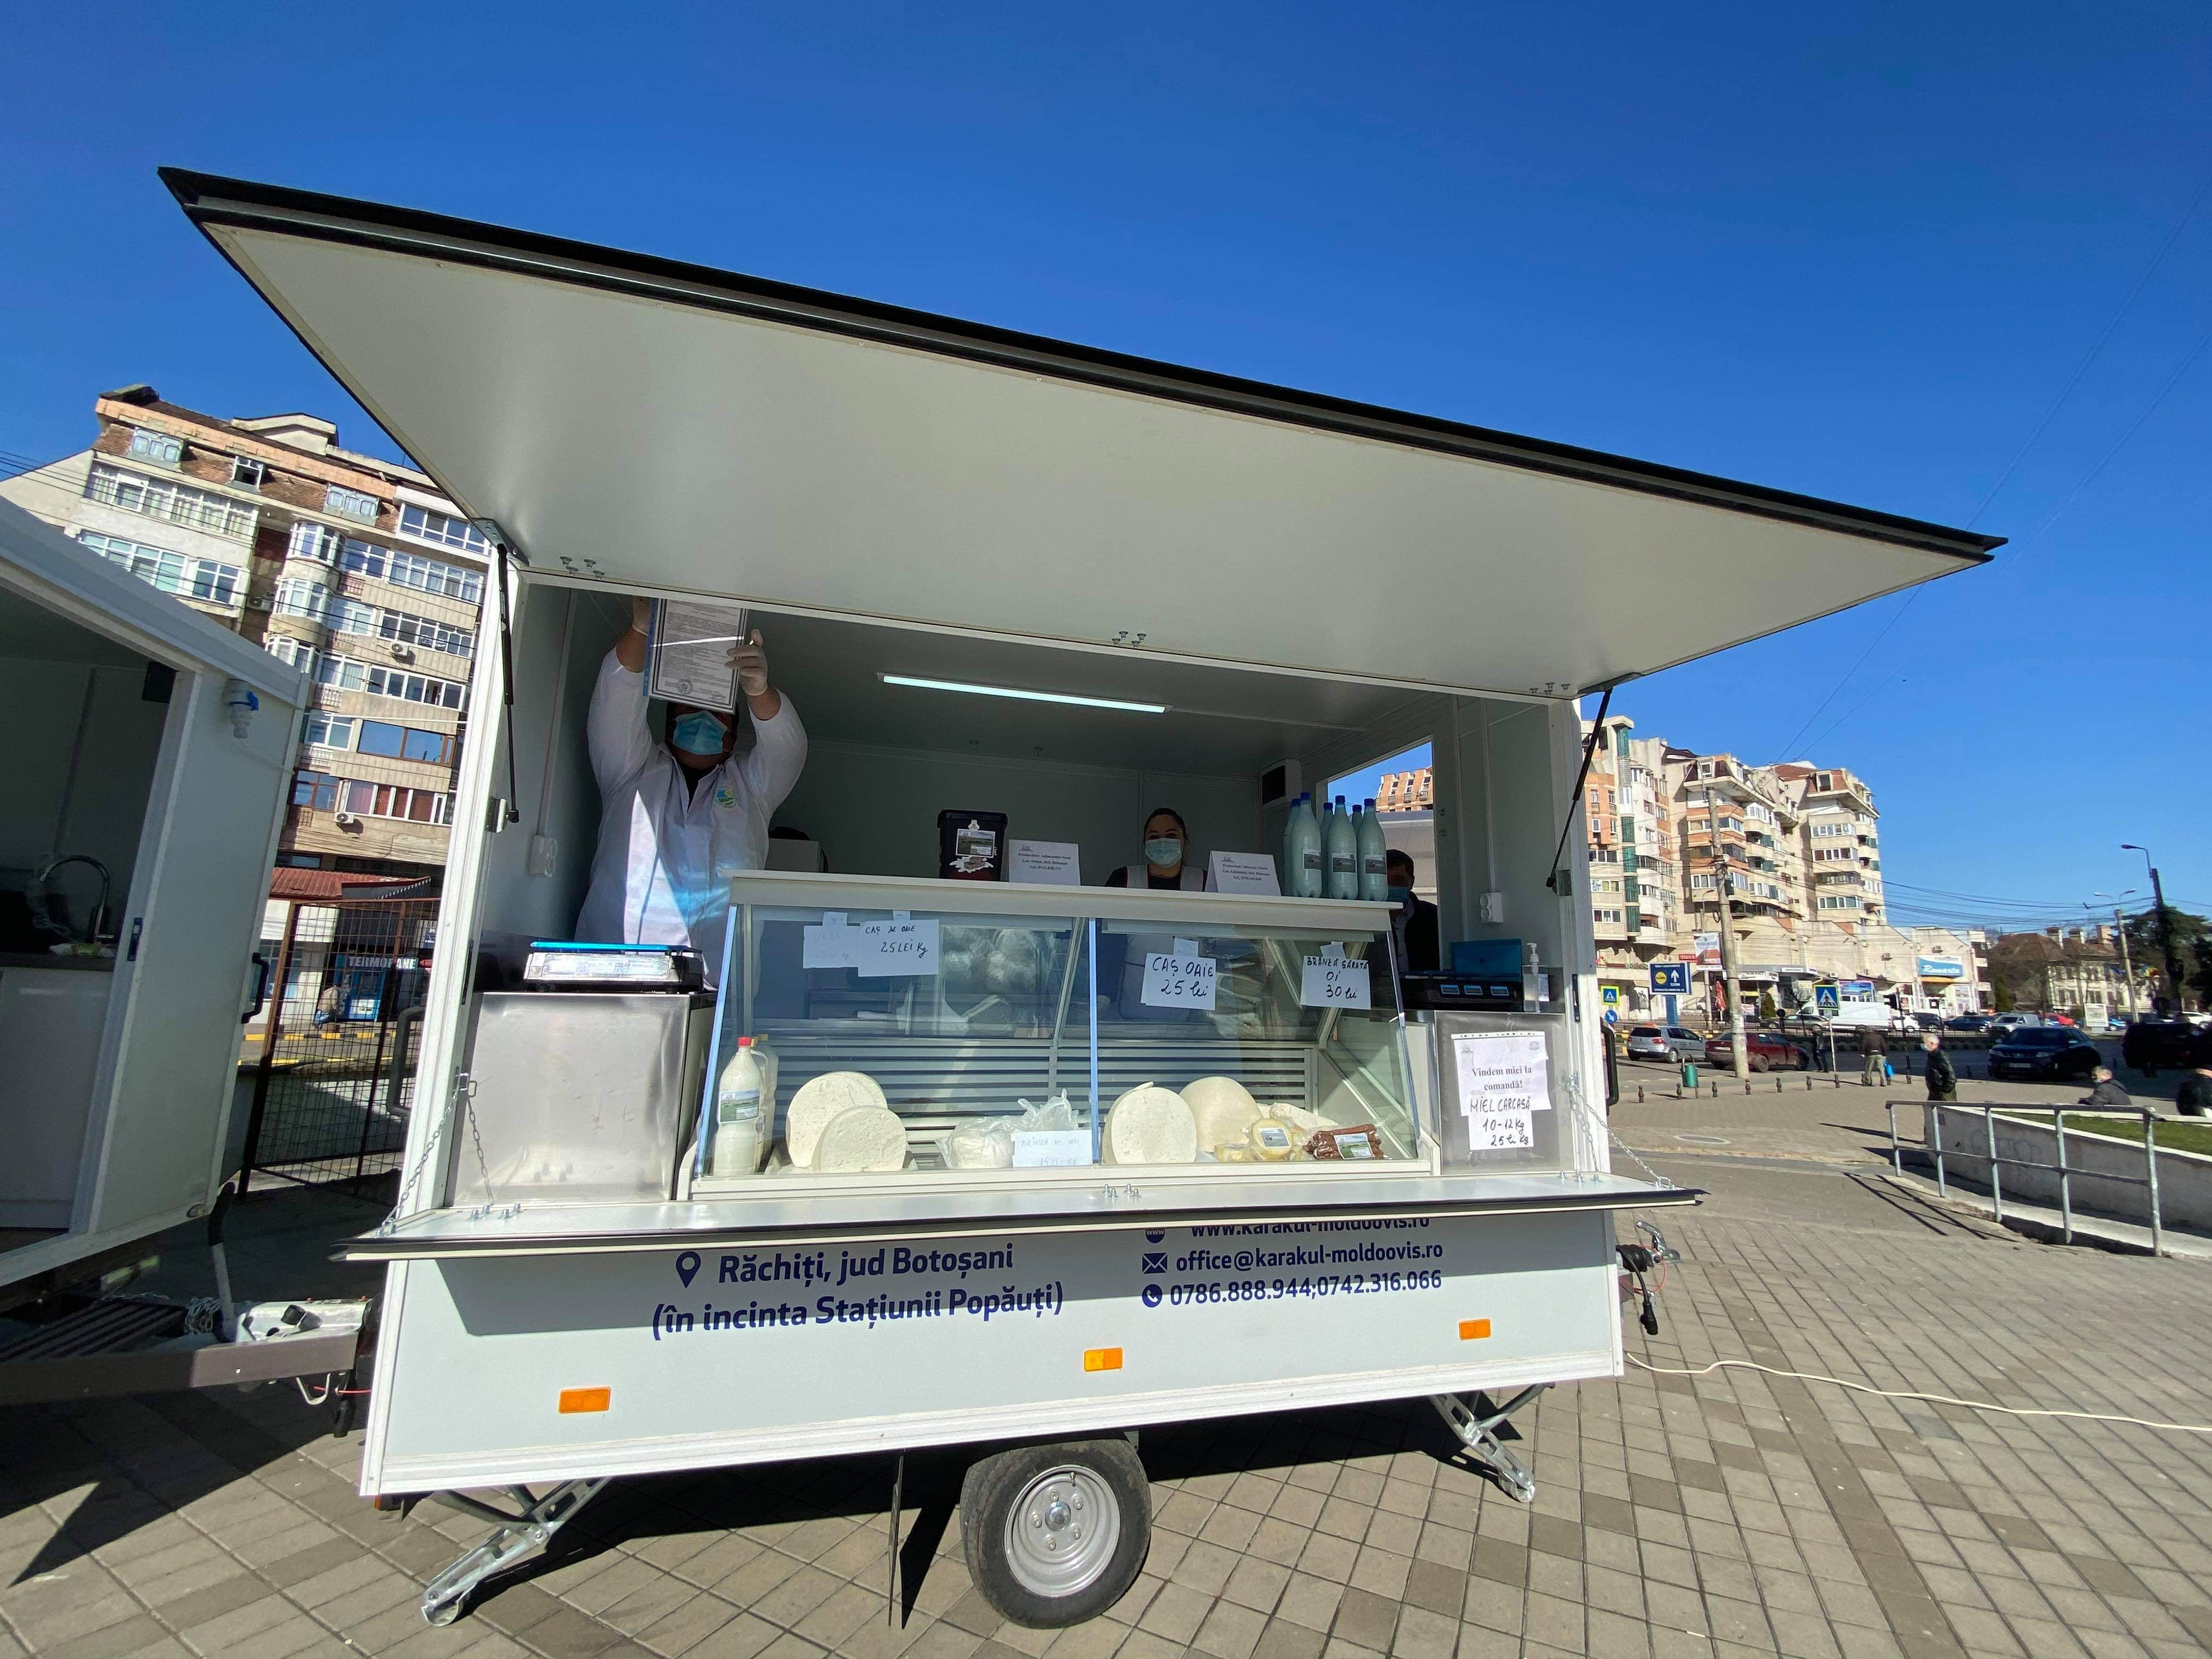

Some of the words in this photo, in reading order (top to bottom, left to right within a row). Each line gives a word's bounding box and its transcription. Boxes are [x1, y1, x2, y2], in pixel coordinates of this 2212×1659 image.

[917, 942, 928, 958] Kg
[1161, 979, 1185, 995] 25
[1190, 981, 1208, 996] lei
[1326, 984, 1342, 997] 30
[1345, 987, 1358, 998] lei
[1472, 1067, 1503, 1076] Vindem
[1506, 1065, 1522, 1075] miei
[1525, 1065, 1532, 1073] la
[1484, 1080, 1523, 1091] comandă!
[1491, 1135, 1504, 1146] 25
[1176, 1242, 1443, 1272] office@karakul-moldoovis.ro
[718, 1252, 831, 1288] Răchiți,
[836, 1249, 884, 1286] jud
[893, 1243, 1013, 1282] Botoșani
[1170, 1269, 1442, 1306] 0786.888.944;0742.316.066
[652, 1302, 694, 1341] (în
[703, 1301, 808, 1330] incinta
[815, 1290, 941, 1330] Stațiunii
[949, 1282, 1064, 1322] Popăuți)
